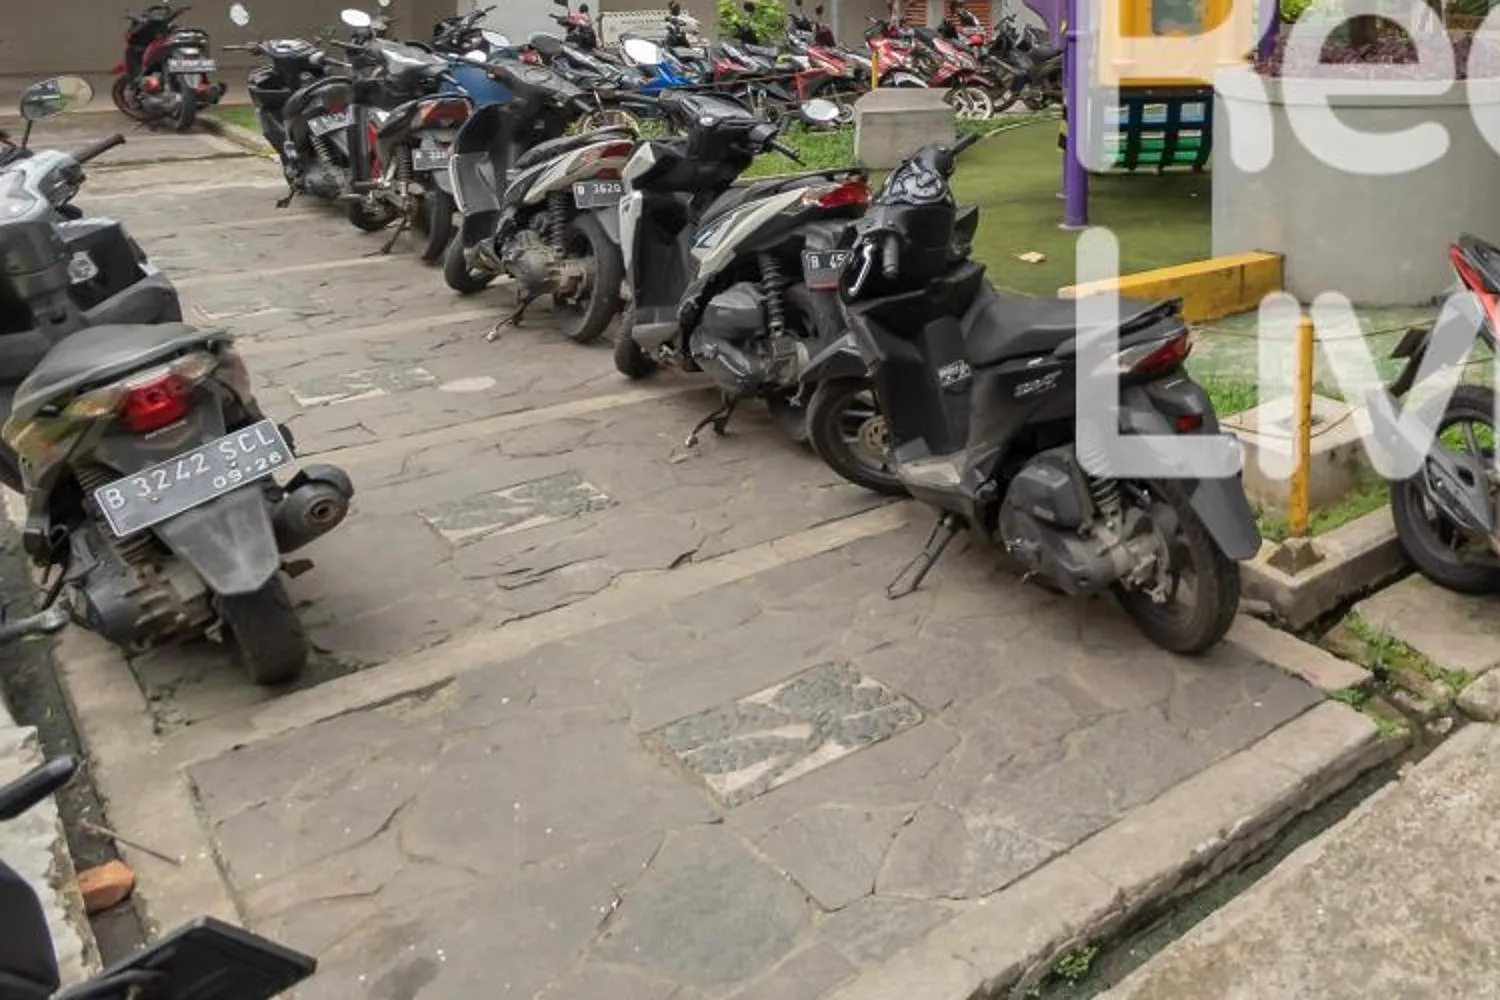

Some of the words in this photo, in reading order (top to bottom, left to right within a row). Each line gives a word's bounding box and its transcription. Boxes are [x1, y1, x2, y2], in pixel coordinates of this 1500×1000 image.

[105, 486, 126, 509] B
[133, 452, 210, 497] 3242
[219, 427, 275, 461] SCL
